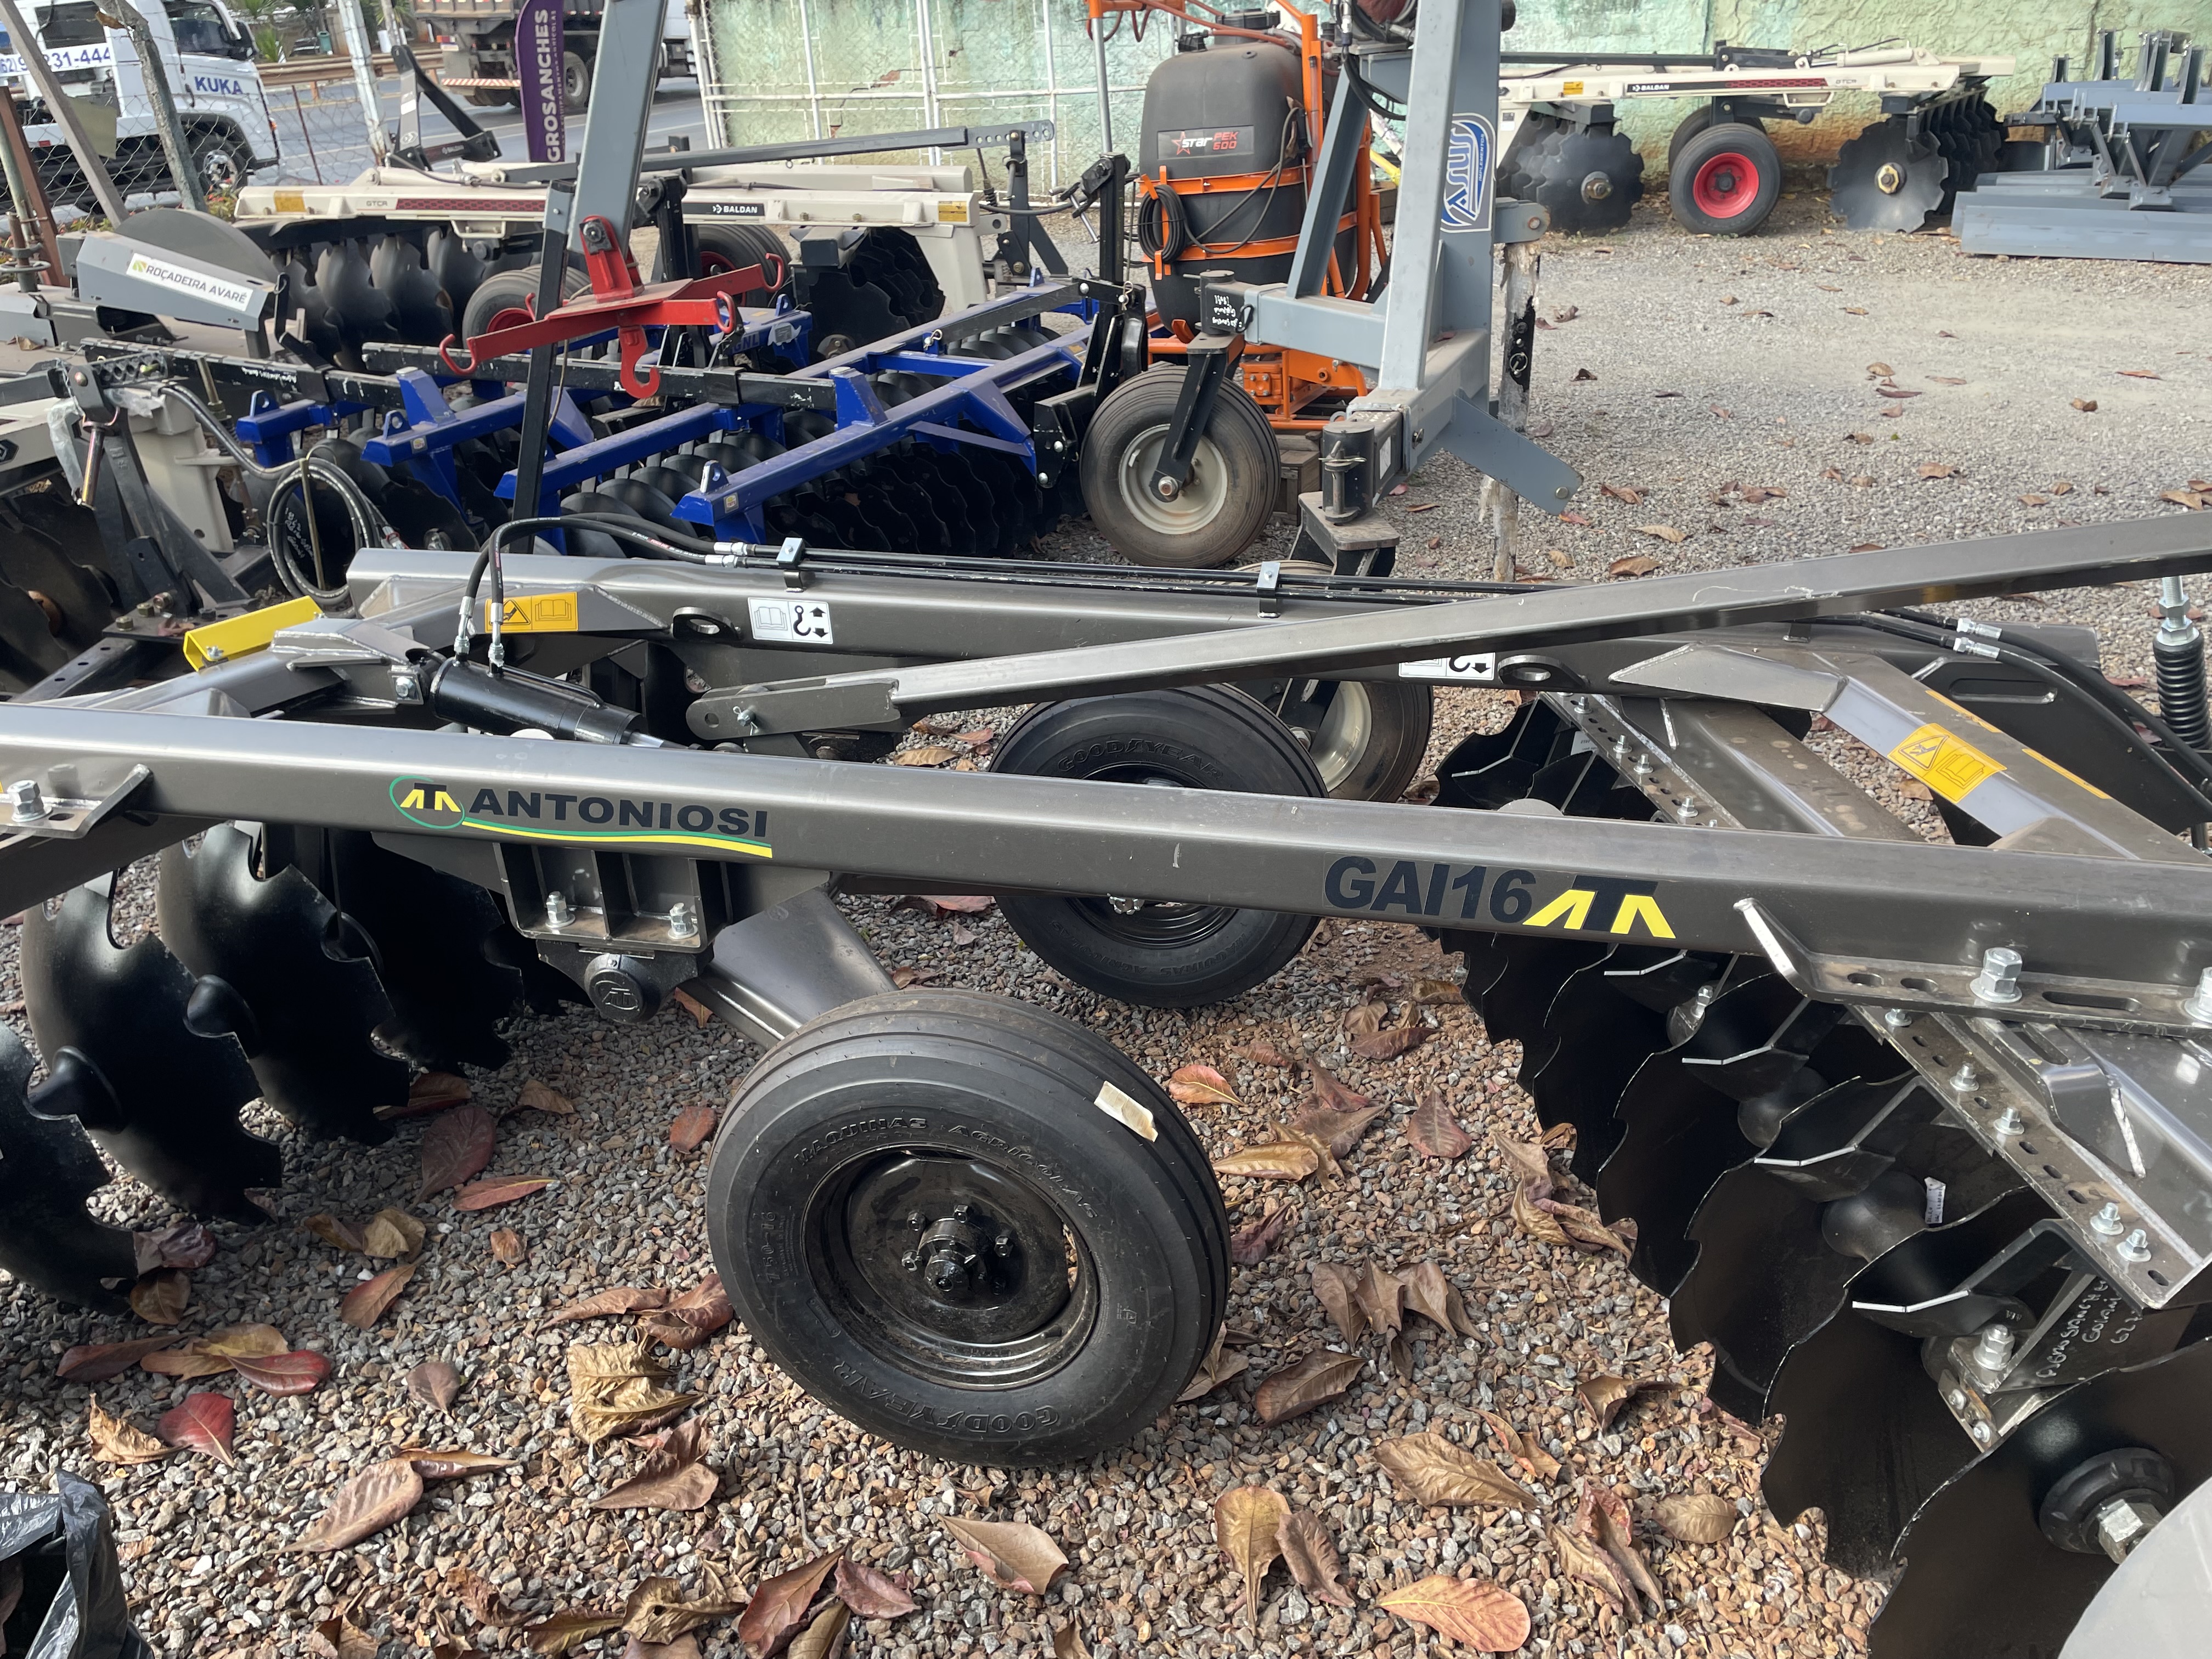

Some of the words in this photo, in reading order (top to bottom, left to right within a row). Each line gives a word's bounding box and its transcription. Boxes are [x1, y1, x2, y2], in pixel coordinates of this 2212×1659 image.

[194, 76, 244, 95] KUKA
[534, 9, 561, 162] GROSANCHES
[1212, 140, 1237, 150] 600
[723, 205, 758, 213] BALDAN
[146, 264, 206, 291] ROÇADEIRA
[209, 285, 247, 303] AVARÉ
[731, 333, 759, 353] GNL
[1058, 738, 1223, 780] GOODYEAR
[469, 788, 768, 837] ANTONIOSI
[1324, 856, 1537, 923] GAI16
[948, 1125, 1098, 1218] AGRICOLAS
[833, 1361, 1059, 1433] GOODYEAR
